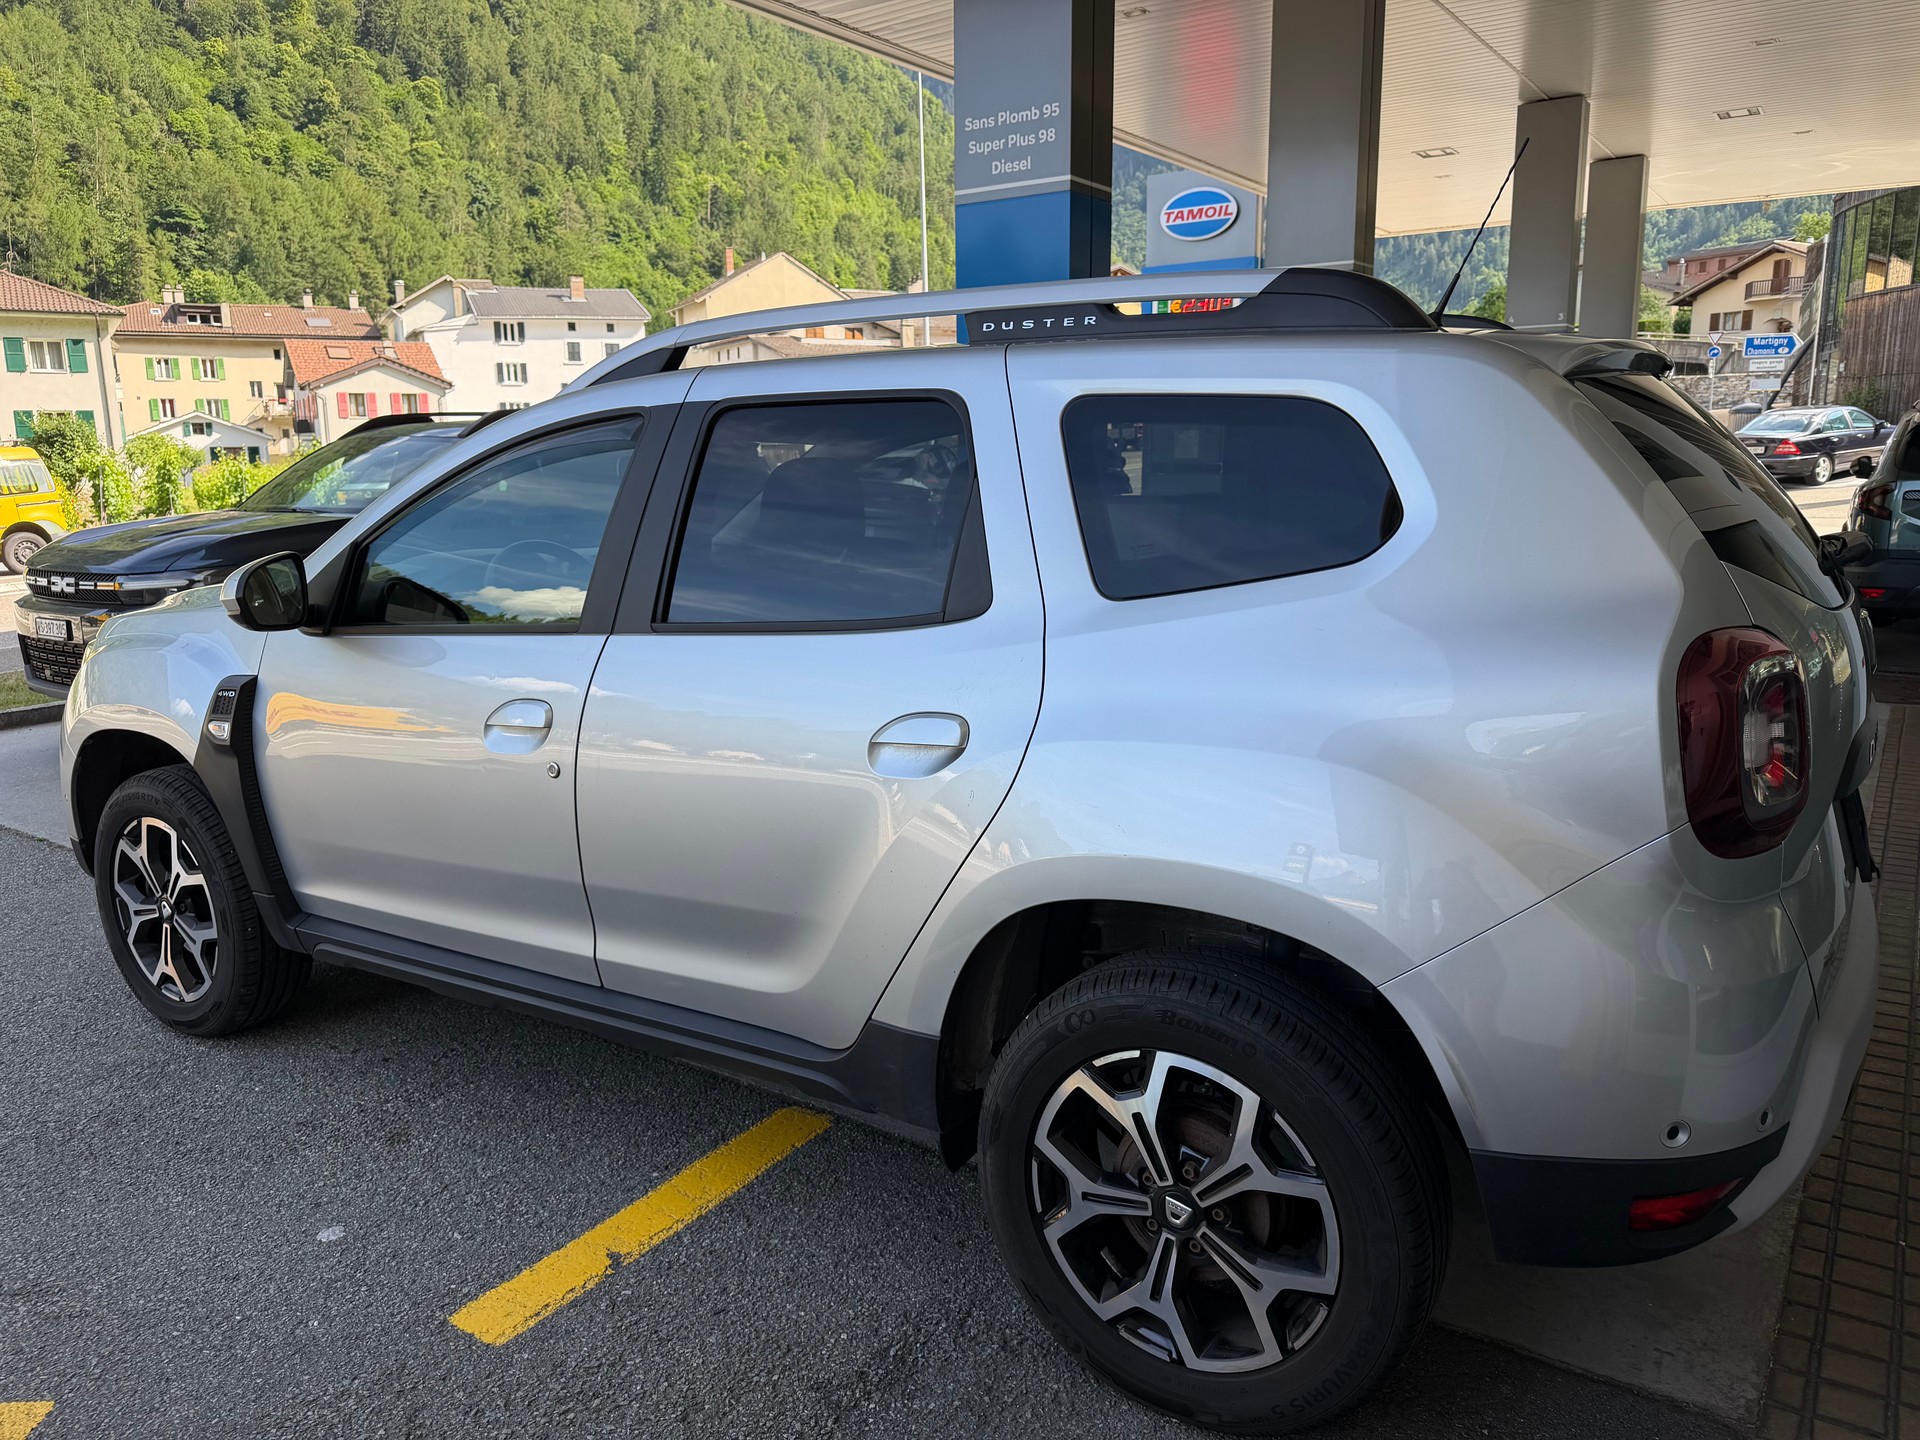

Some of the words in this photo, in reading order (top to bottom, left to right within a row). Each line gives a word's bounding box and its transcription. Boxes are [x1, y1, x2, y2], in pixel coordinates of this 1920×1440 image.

[964, 117, 995, 131] Sans
[998, 105, 1040, 126] Plomb
[1042, 102, 1060, 118] 95
[968, 138, 1006, 155] Super
[1008, 133, 1036, 148] Plus
[1038, 128, 1056, 144] 98
[991, 155, 1031, 175] Diesel
[1164, 204, 1233, 224] TAMOIL
[982, 315, 1097, 332] DUSTER
[1747, 347, 1775, 355] Chamonix
[1753, 337, 1788, 346] Martigny
[1159, 1008, 1238, 1049] Barum
[1289, 1328, 1377, 1415] BRAVURIS
